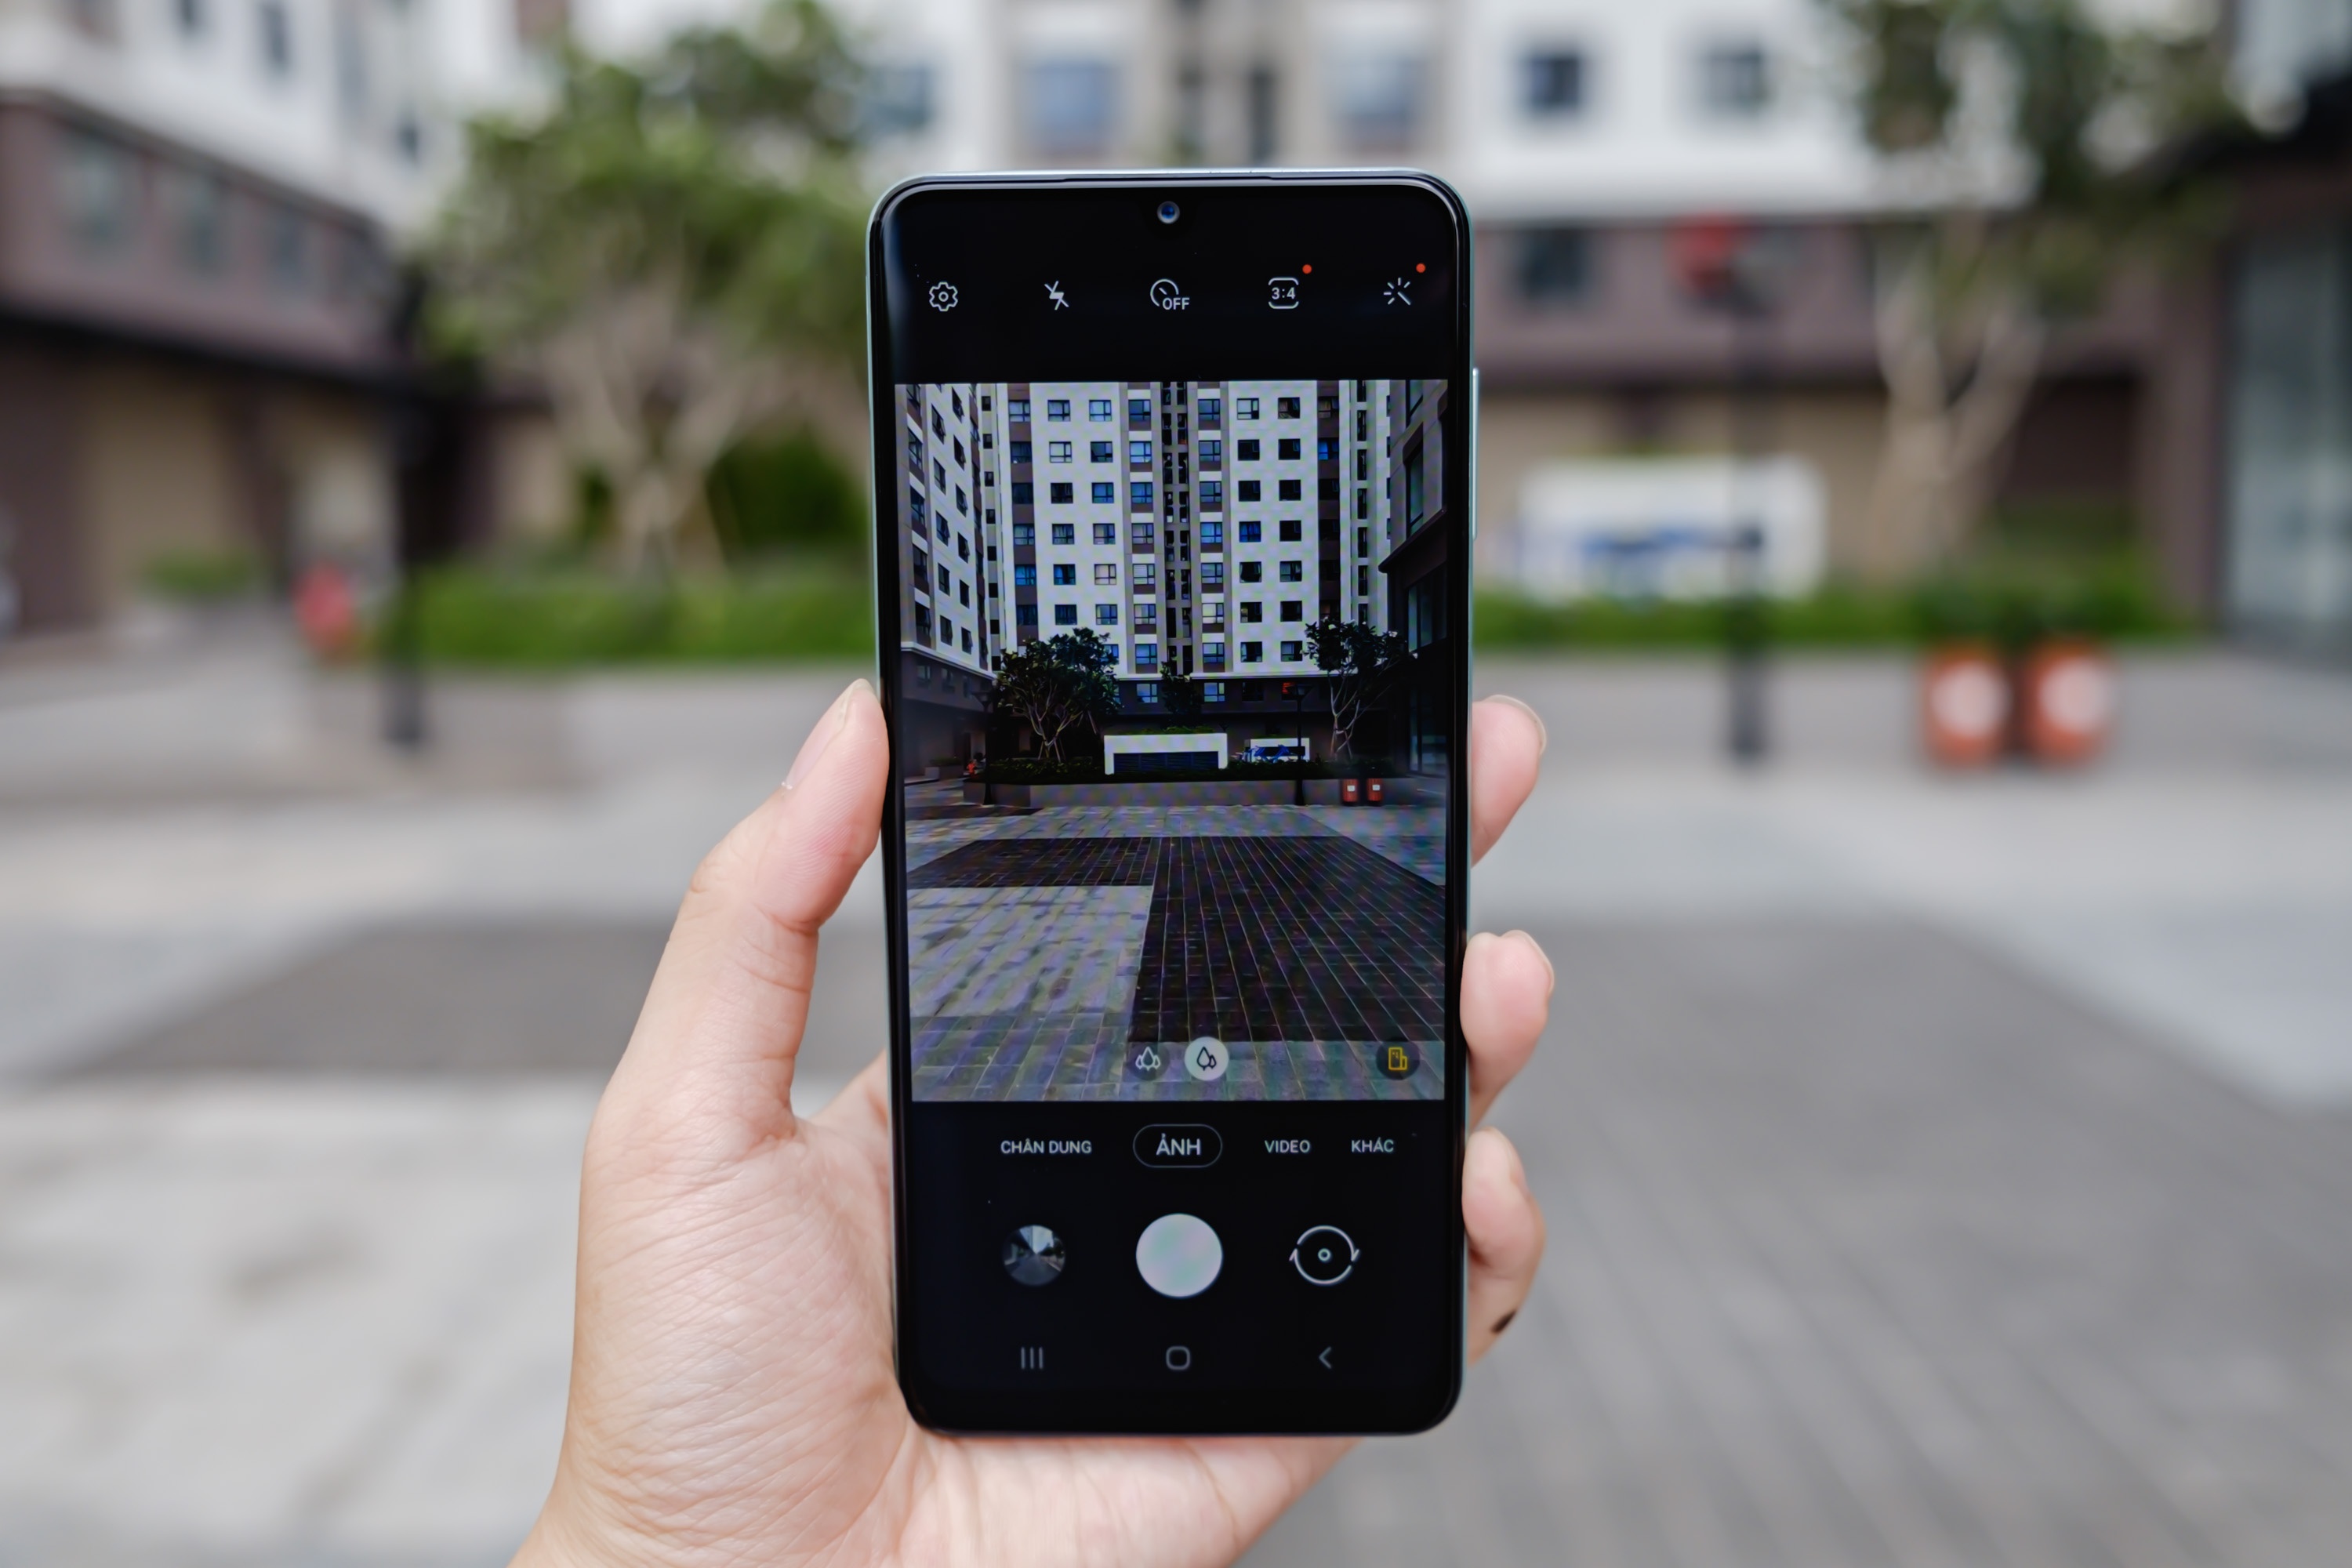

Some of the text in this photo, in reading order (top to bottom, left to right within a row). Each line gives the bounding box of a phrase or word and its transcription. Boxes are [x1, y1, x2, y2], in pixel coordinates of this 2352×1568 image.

[1272, 287, 1296, 299] 3:4
[1162, 297, 1190, 310] OFF
[1000, 1138, 1092, 1154] CHÂN DUNG
[1156, 1133, 1202, 1156] ẢNH
[1264, 1139, 1311, 1153] VIDEO
[1351, 1137, 1395, 1153] KHÁC
